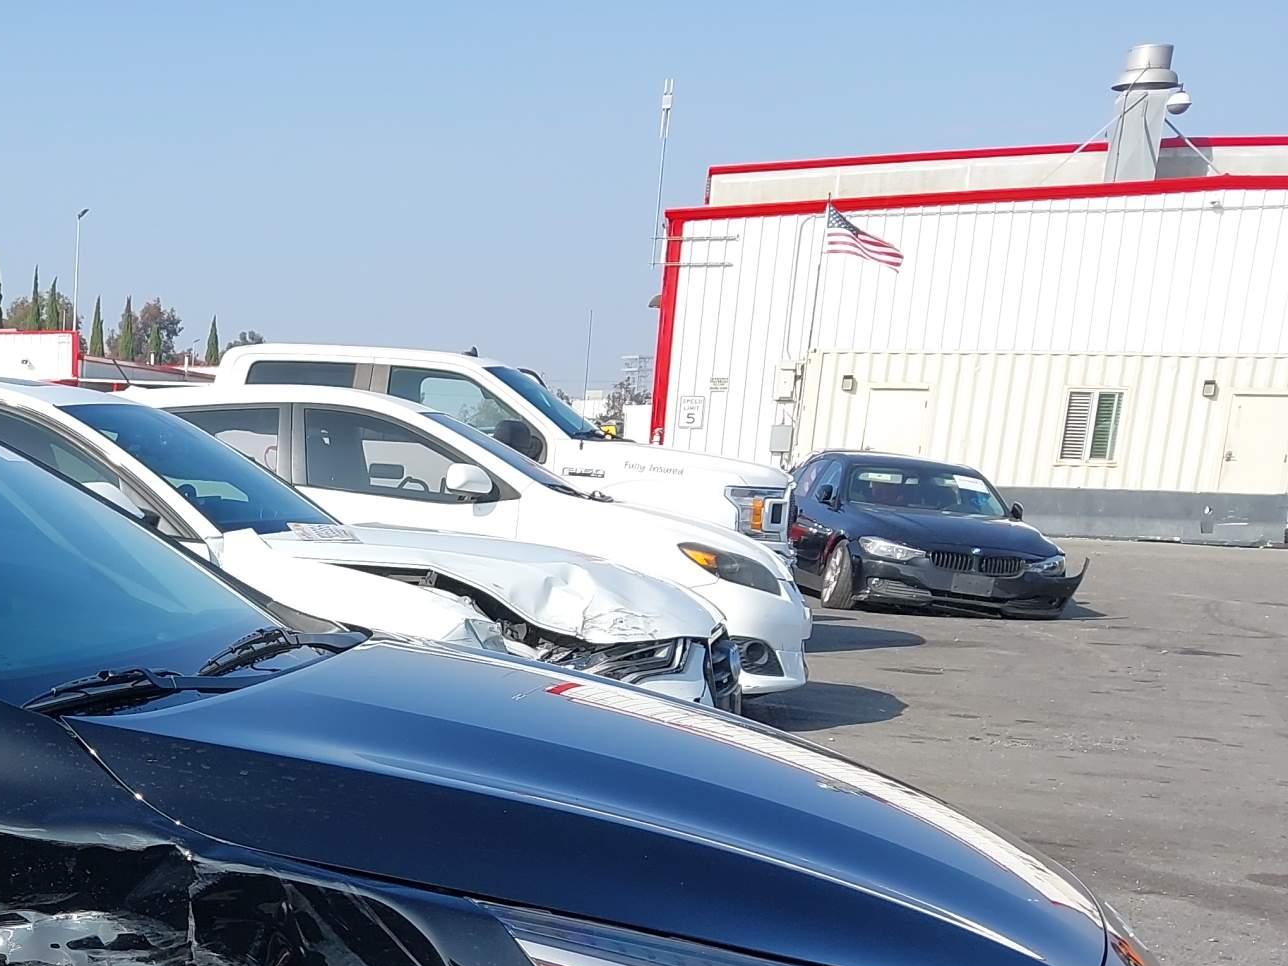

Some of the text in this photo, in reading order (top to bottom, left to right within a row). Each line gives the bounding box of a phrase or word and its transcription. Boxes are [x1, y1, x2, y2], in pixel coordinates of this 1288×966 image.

[685, 412, 696, 424] 5
[624, 460, 685, 476] Fully Insured
